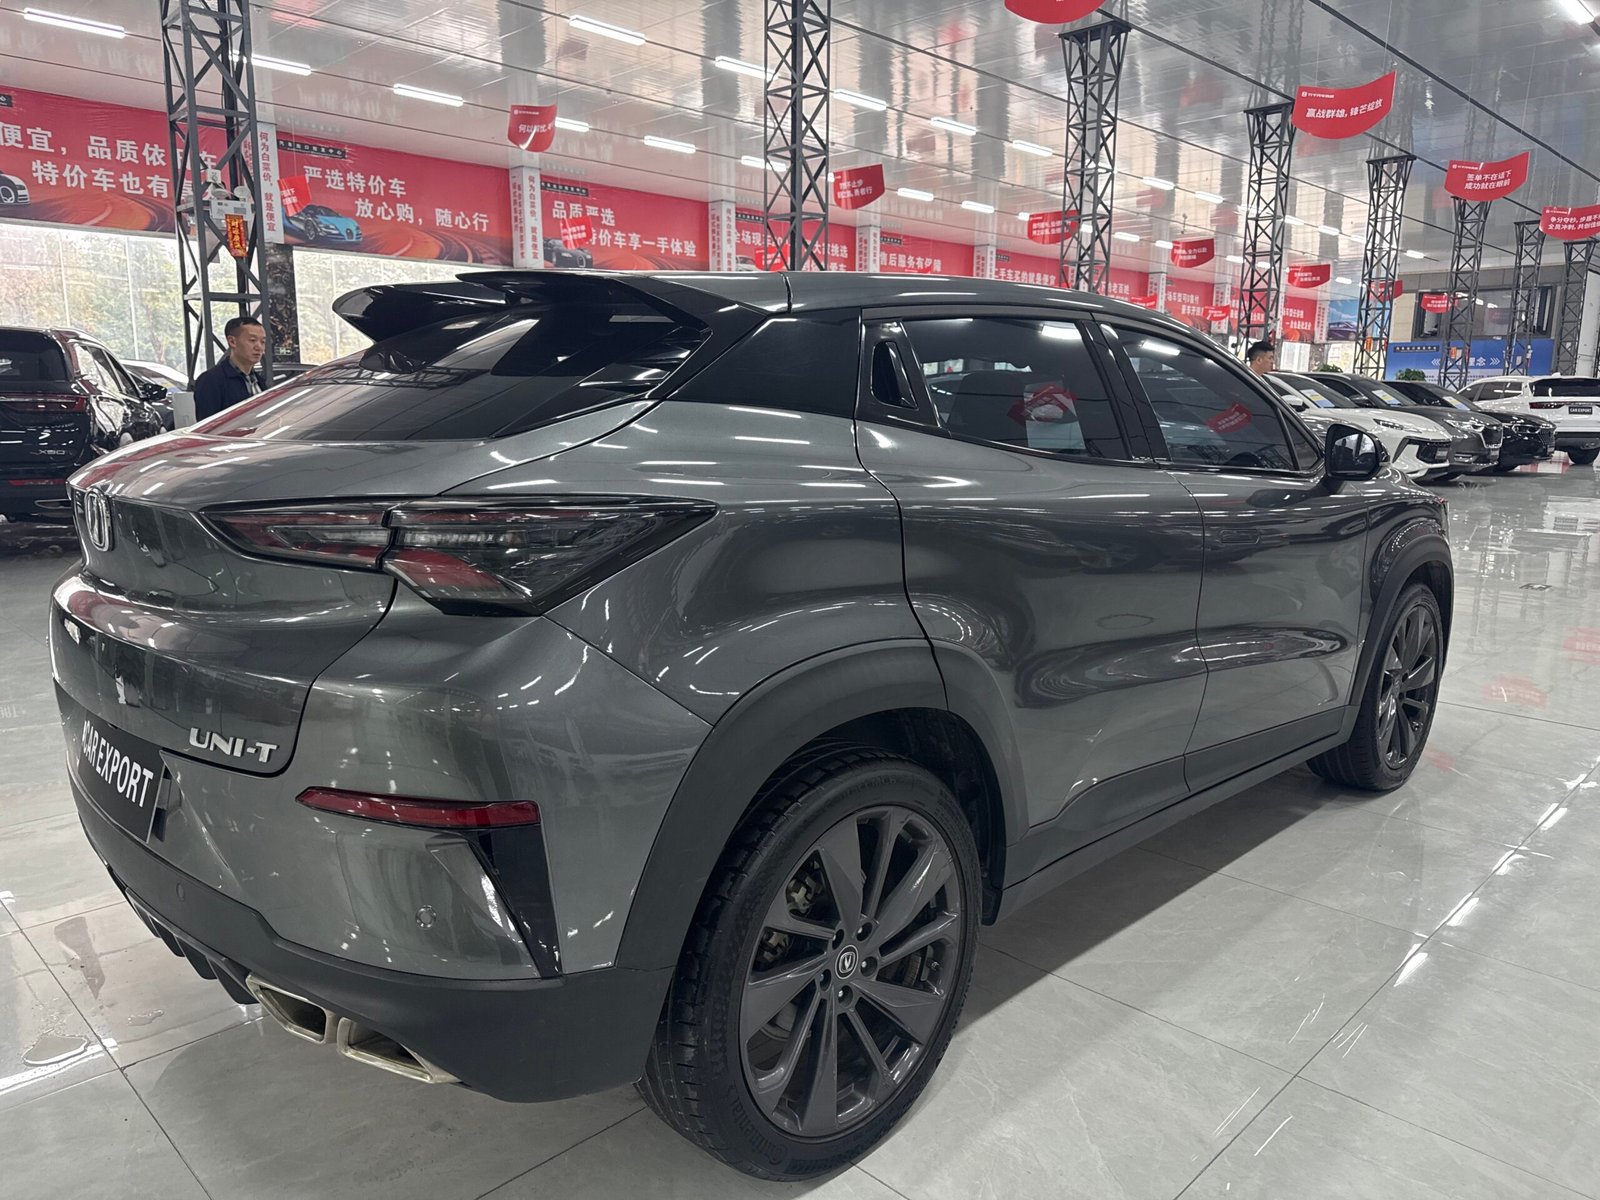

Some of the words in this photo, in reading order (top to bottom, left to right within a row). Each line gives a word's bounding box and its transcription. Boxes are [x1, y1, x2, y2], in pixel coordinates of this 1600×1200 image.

[303, 165, 406, 198] 严选特价车
[355, 198, 489, 232] 放心购，随心行
[189, 727, 279, 763] UNI-T
[95, 736, 154, 808] EXPORT
